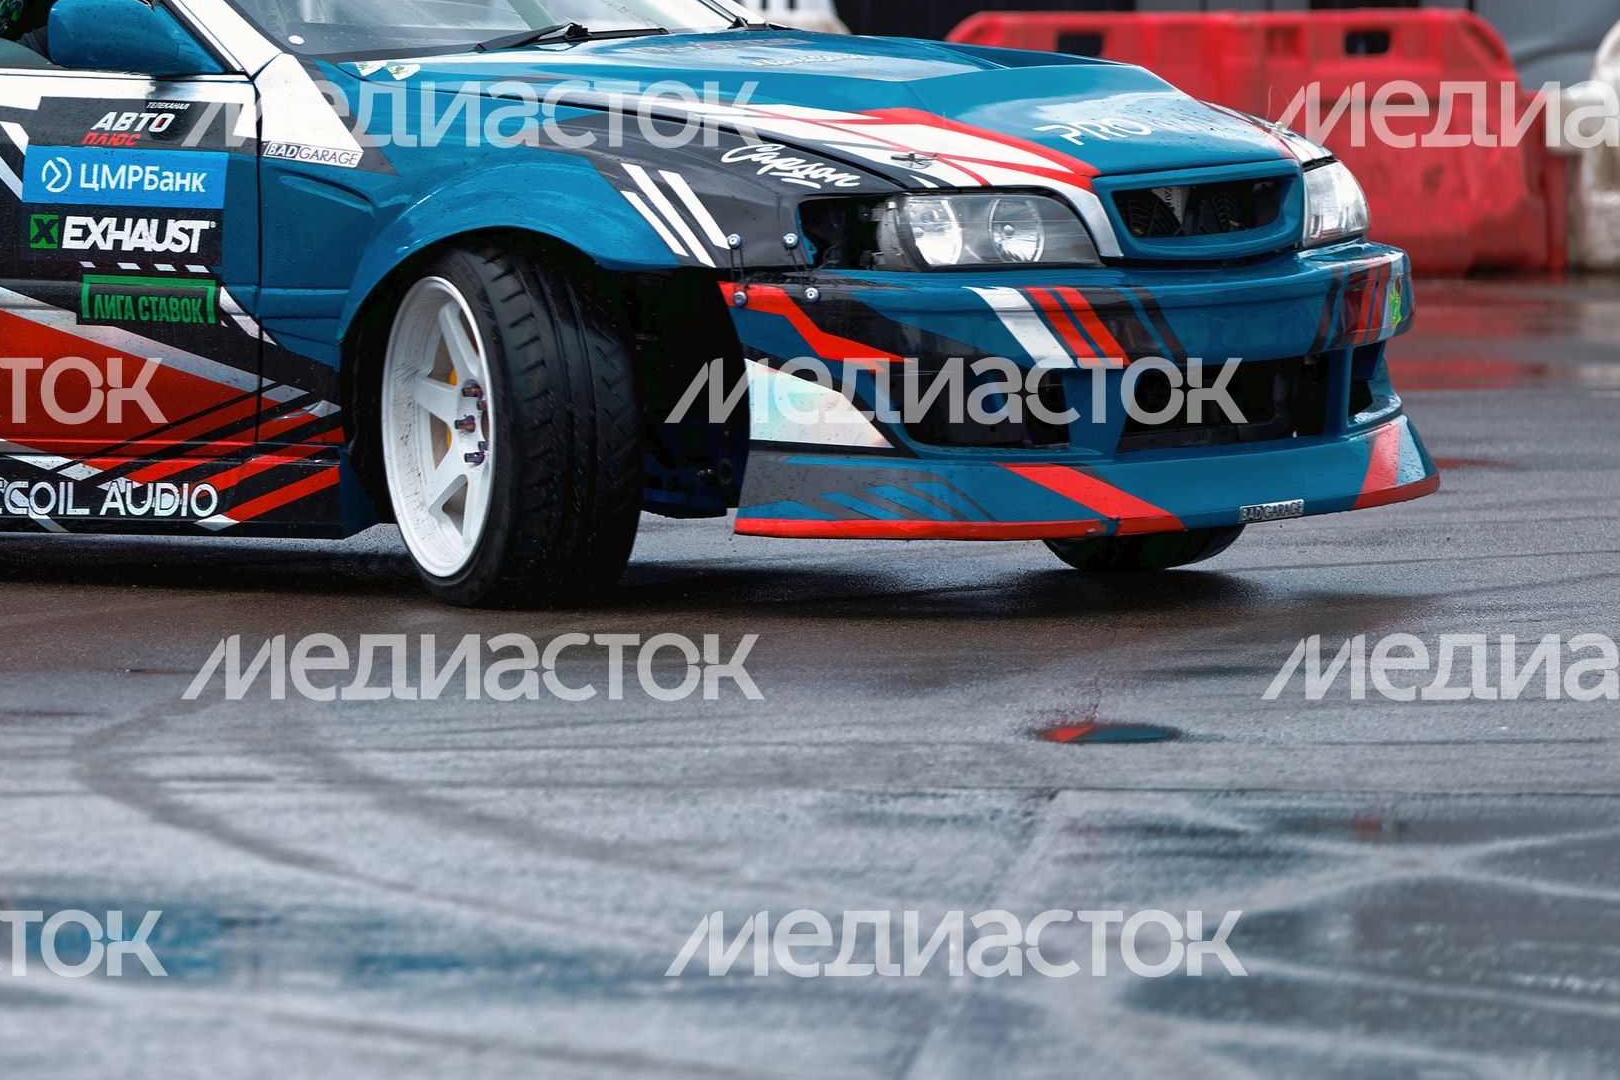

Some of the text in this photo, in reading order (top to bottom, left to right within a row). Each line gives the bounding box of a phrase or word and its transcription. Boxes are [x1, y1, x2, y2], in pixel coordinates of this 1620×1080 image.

[146, 101, 191, 111] ТЕЛЕКАНАЛ
[91, 111, 176, 133] АВТО
[1033, 117, 1152, 146] PRO
[81, 132, 141, 148] ПЛЮС
[79, 164, 208, 193] ЦМРБанк
[93, 294, 204, 323] ЛИГА СТАВОК
[99, 481, 218, 517] AUDIO
